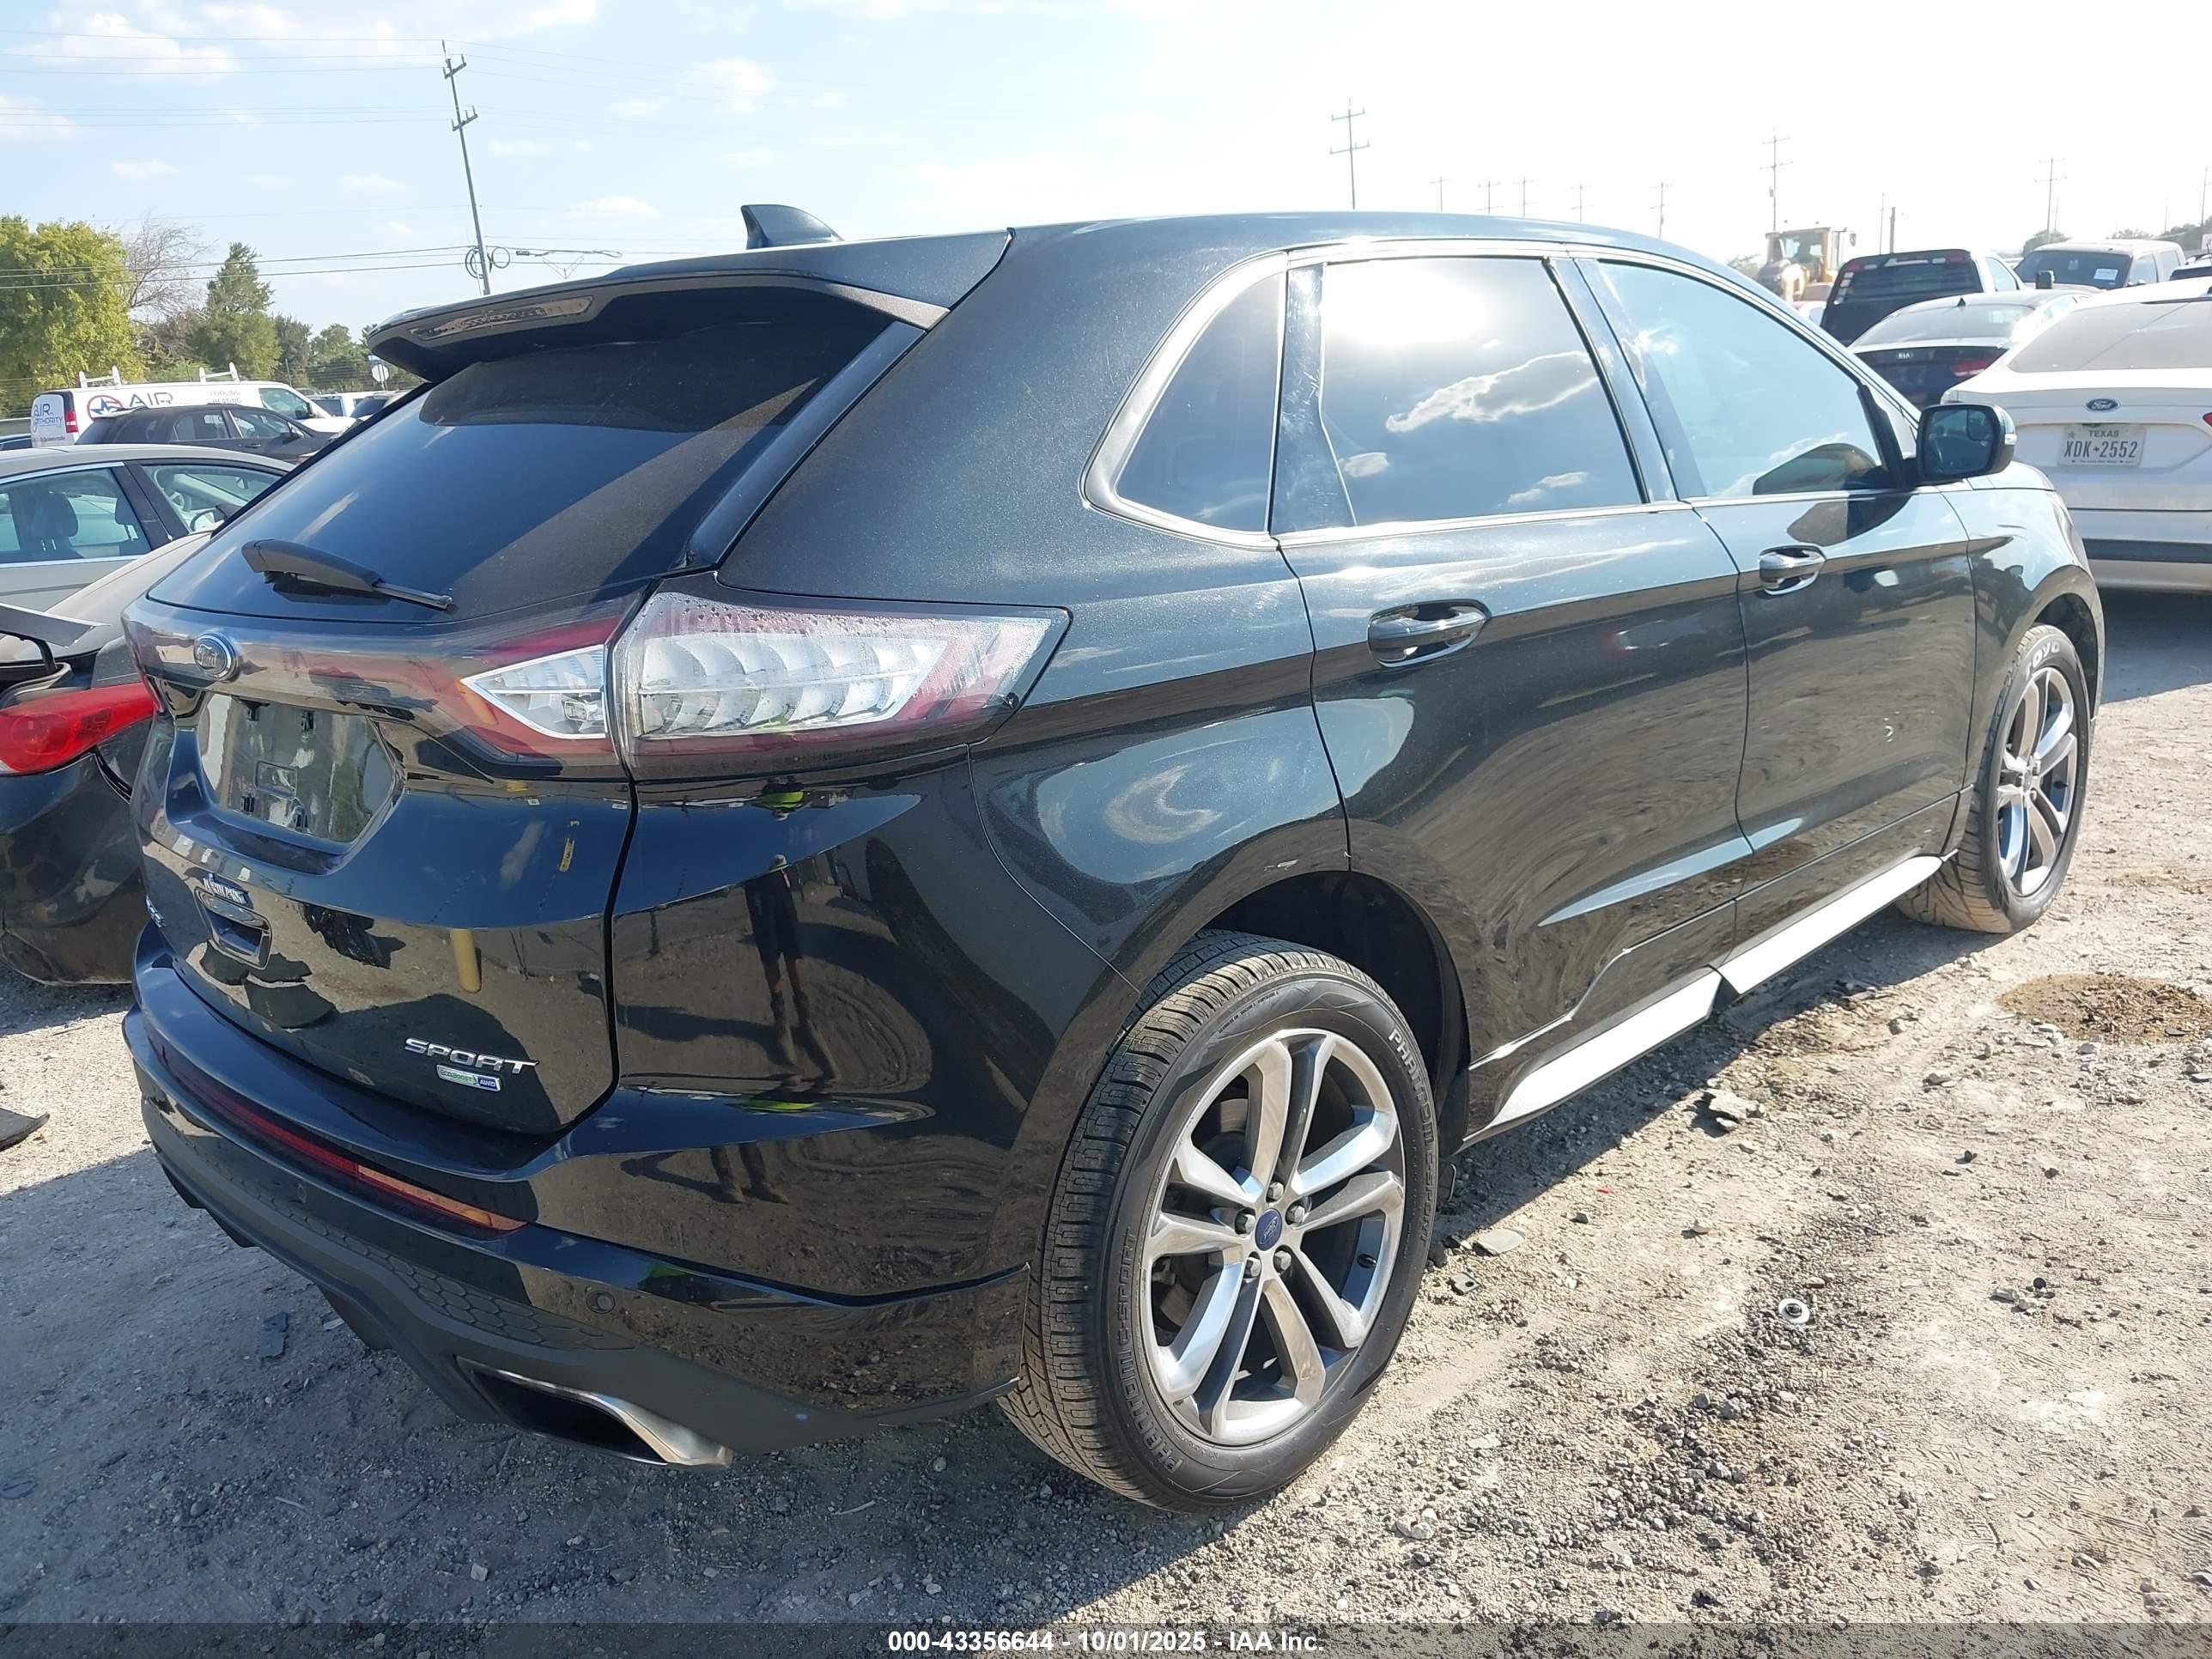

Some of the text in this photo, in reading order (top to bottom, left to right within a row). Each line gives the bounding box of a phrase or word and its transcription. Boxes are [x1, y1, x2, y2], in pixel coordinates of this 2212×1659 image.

[128, 392, 174, 408] AIR
[2088, 429, 2119, 438] TEXAS
[196, 643, 219, 668] Ford
[404, 1037, 540, 1073] SPORT
[1388, 1028, 1434, 1145] PHANTOM
[1118, 1226, 1183, 1473] PHANTOM C-SPORT
